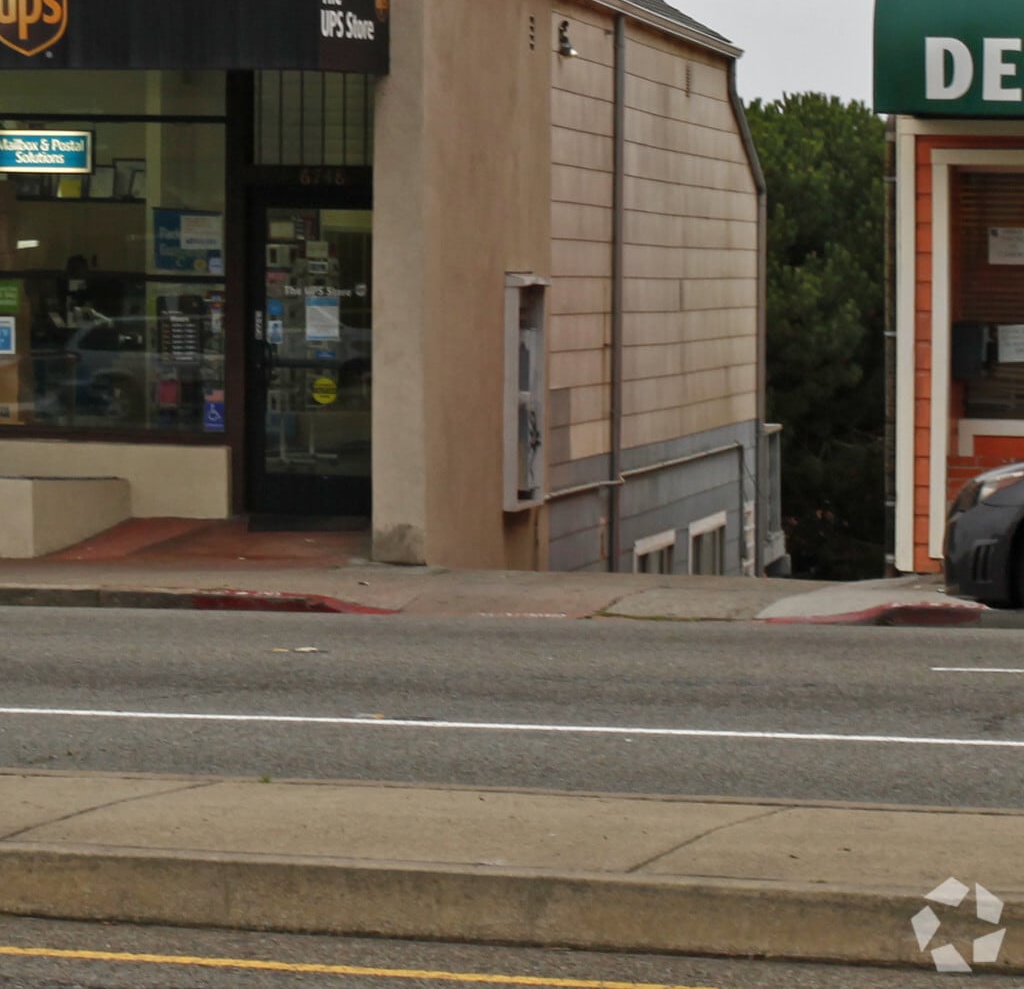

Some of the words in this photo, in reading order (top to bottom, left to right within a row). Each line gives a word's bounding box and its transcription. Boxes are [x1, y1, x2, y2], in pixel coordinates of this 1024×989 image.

[320, 9, 344, 38] UPS
[345, 11, 375, 40] Store
[925, 37, 1022, 102] DE
[41, 138, 50, 152] &
[52, 138, 84, 152] Postal
[15, 151, 65, 165] Solutions
